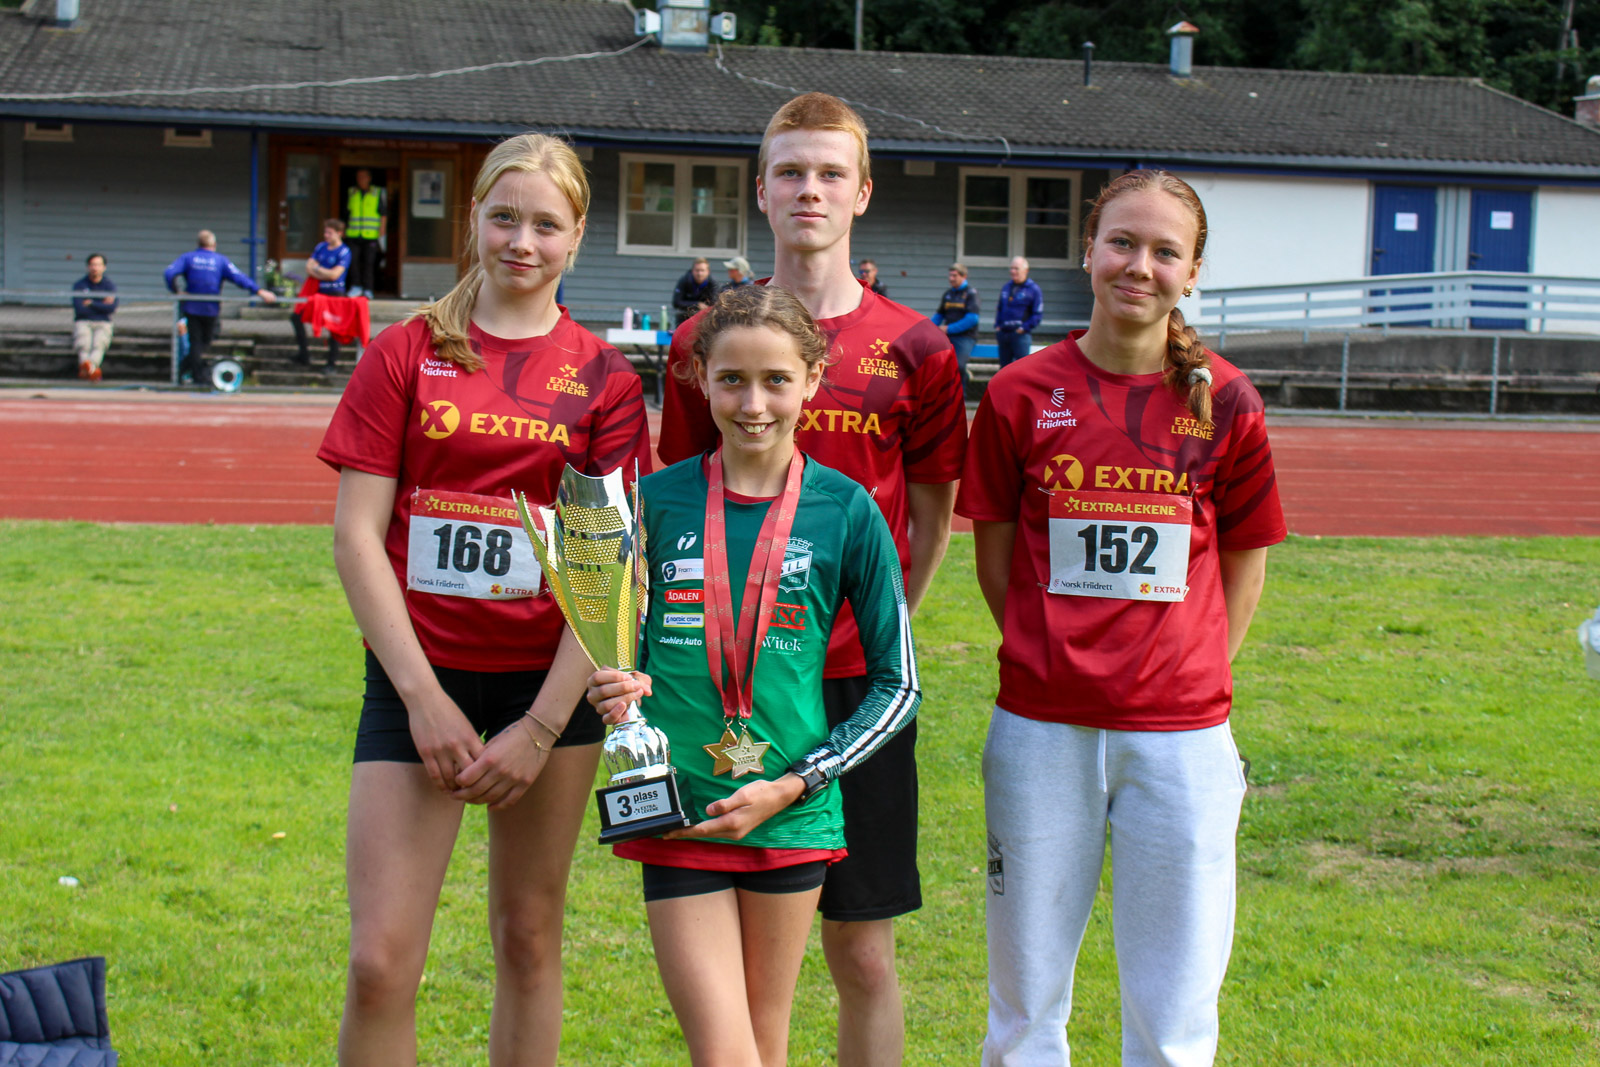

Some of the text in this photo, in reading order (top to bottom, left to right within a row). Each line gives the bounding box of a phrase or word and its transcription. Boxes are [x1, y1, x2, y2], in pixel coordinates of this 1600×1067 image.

[425, 358, 453, 368] Norsk
[860, 357, 899, 370] EXTRA-
[857, 365, 899, 379] LEKENE
[546, 383, 589, 398] LEKENE
[550, 376, 589, 391] EXTRA-
[1042, 408, 1073, 419] Norsk
[796, 408, 881, 435] XTRA
[1036, 418, 1078, 429] Friidrett
[470, 412, 571, 447] EXTRA
[1171, 424, 1215, 441] LEKENE
[1094, 464, 1190, 495] EXTRA
[1081, 501, 1177, 516] EXTRA-LEKENE
[433, 523, 513, 577] 168
[1077, 524, 1159, 575] 152
[416, 577, 465, 590] Norsk Friidrett
[1060, 580, 1113, 591] Norsk Friidrett
[1154, 586, 1181, 594] EXTRA
[504, 587, 535, 596] EXTRA
[668, 591, 699, 601] ÅDALEN
[684, 637, 703, 646] Auto
[762, 635, 802, 652] Witek
[617, 790, 659, 818] 3 plass
